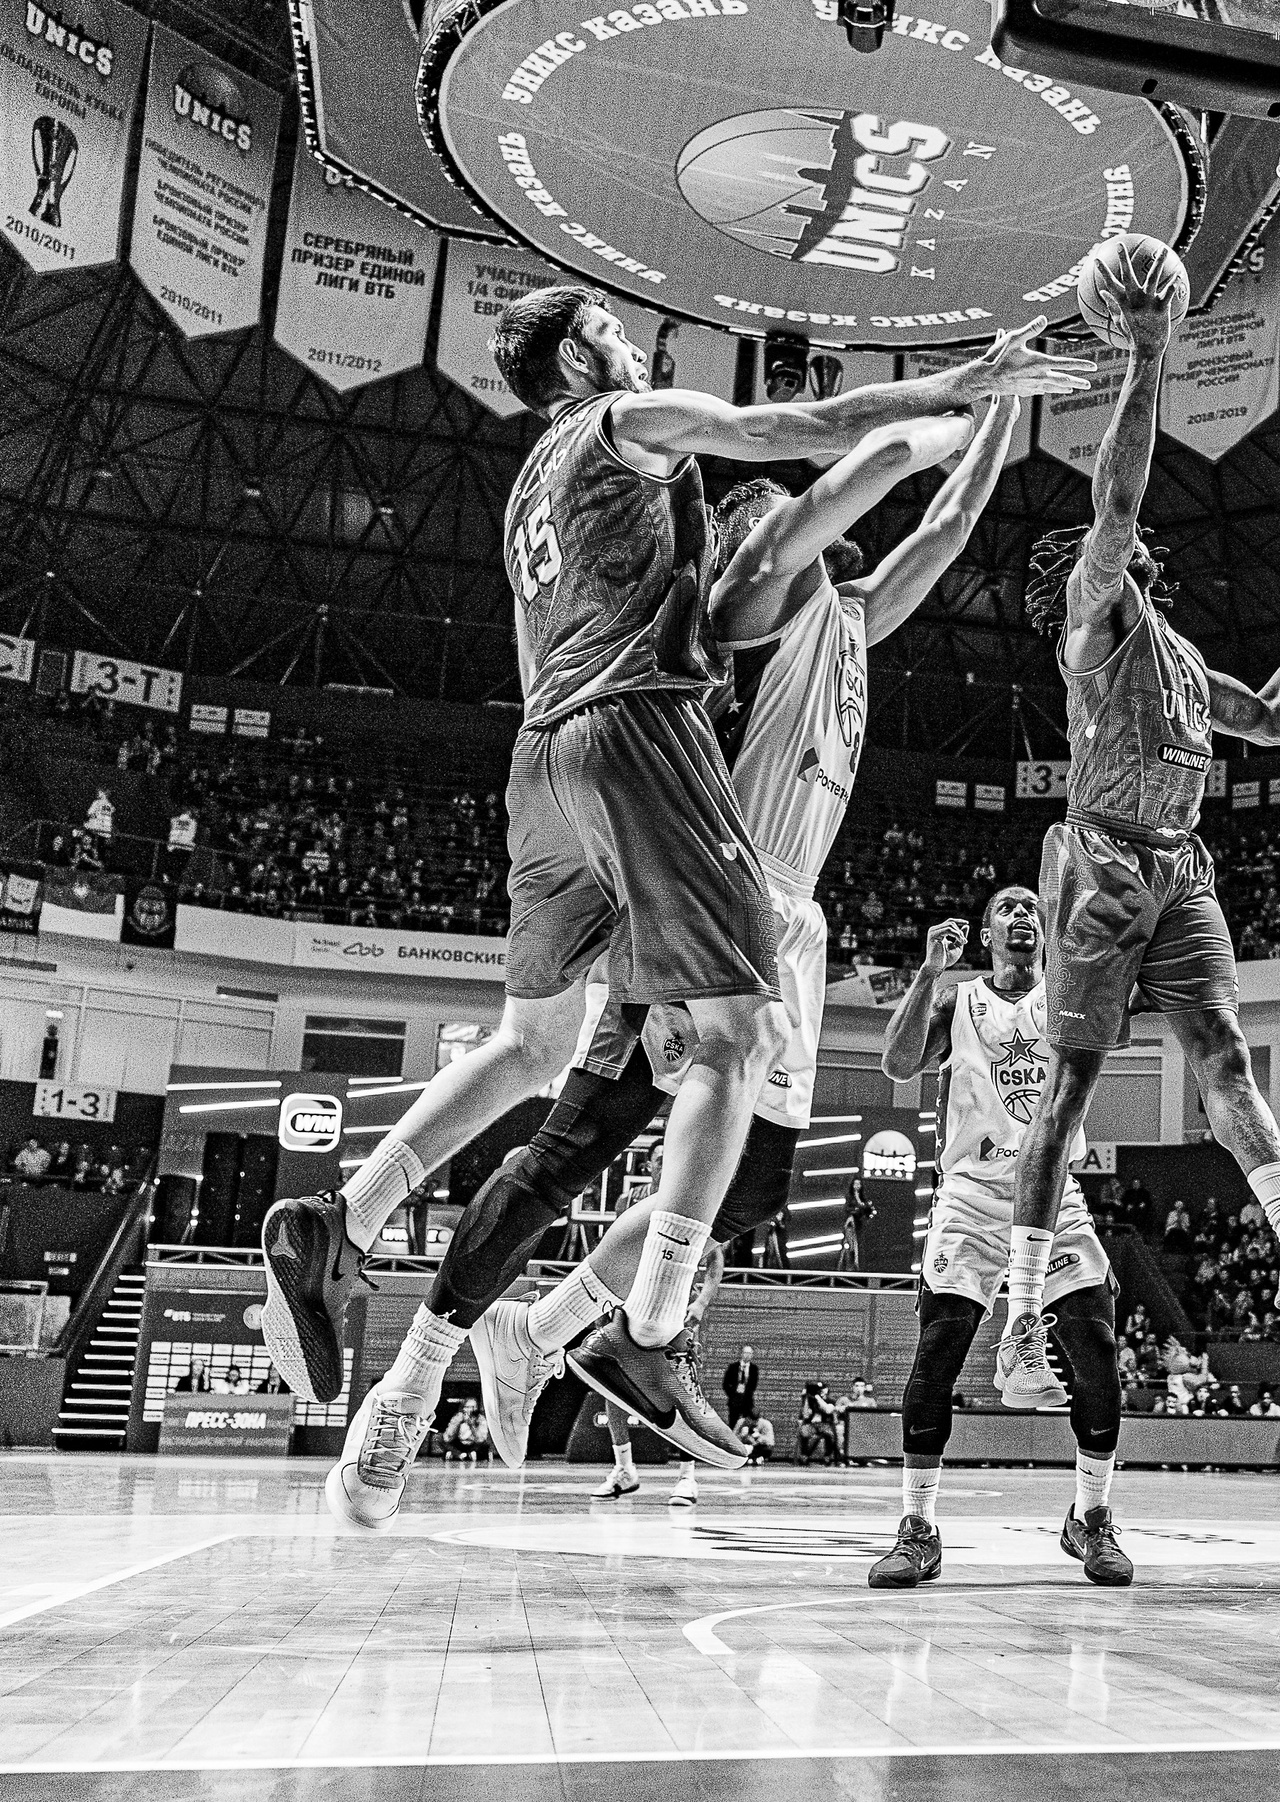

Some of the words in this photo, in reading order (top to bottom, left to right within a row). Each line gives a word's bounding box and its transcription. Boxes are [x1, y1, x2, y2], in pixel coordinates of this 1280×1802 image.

[26, 1, 114, 76] UNICS
[174, 84, 252, 151] UNICS
[797, 112, 953, 274] UNICS
[910, 141, 997, 281] KAZAN
[5, 215, 76, 261] 2010/2011
[303, 231, 415, 266] СЕРЕБРЯНЫЙ
[291, 248, 355, 273] ПРИЗЕР
[359, 261, 426, 287] ЕДИНОЙ
[315, 272, 360, 293] ЛИГИ
[364, 281, 396, 300] ВТБ
[467, 280, 489, 297] 1/4
[160, 285, 224, 325] 2010/2011
[1226, 333, 1246, 346] ВТБ
[307, 347, 383, 373] 2011/2012
[1197, 374, 1240, 389] РОССИИ
[1187, 406, 1248, 425] 2018/2019
[513, 492, 562, 603] 15
[1162, 746, 1206, 770] WINLINE
[397, 946, 506, 966] БАНКОВСКИЕ
[1058, 1010, 1086, 1020] MAXX
[665, 1041, 683, 1052] CSKA
[999, 1067, 1047, 1087] CSKA
[294, 1112, 341, 1134] WIN
[661, 1249, 675, 1261] 15
[185, 1412, 267, 1430] ПРЕСС-ЗОНА
